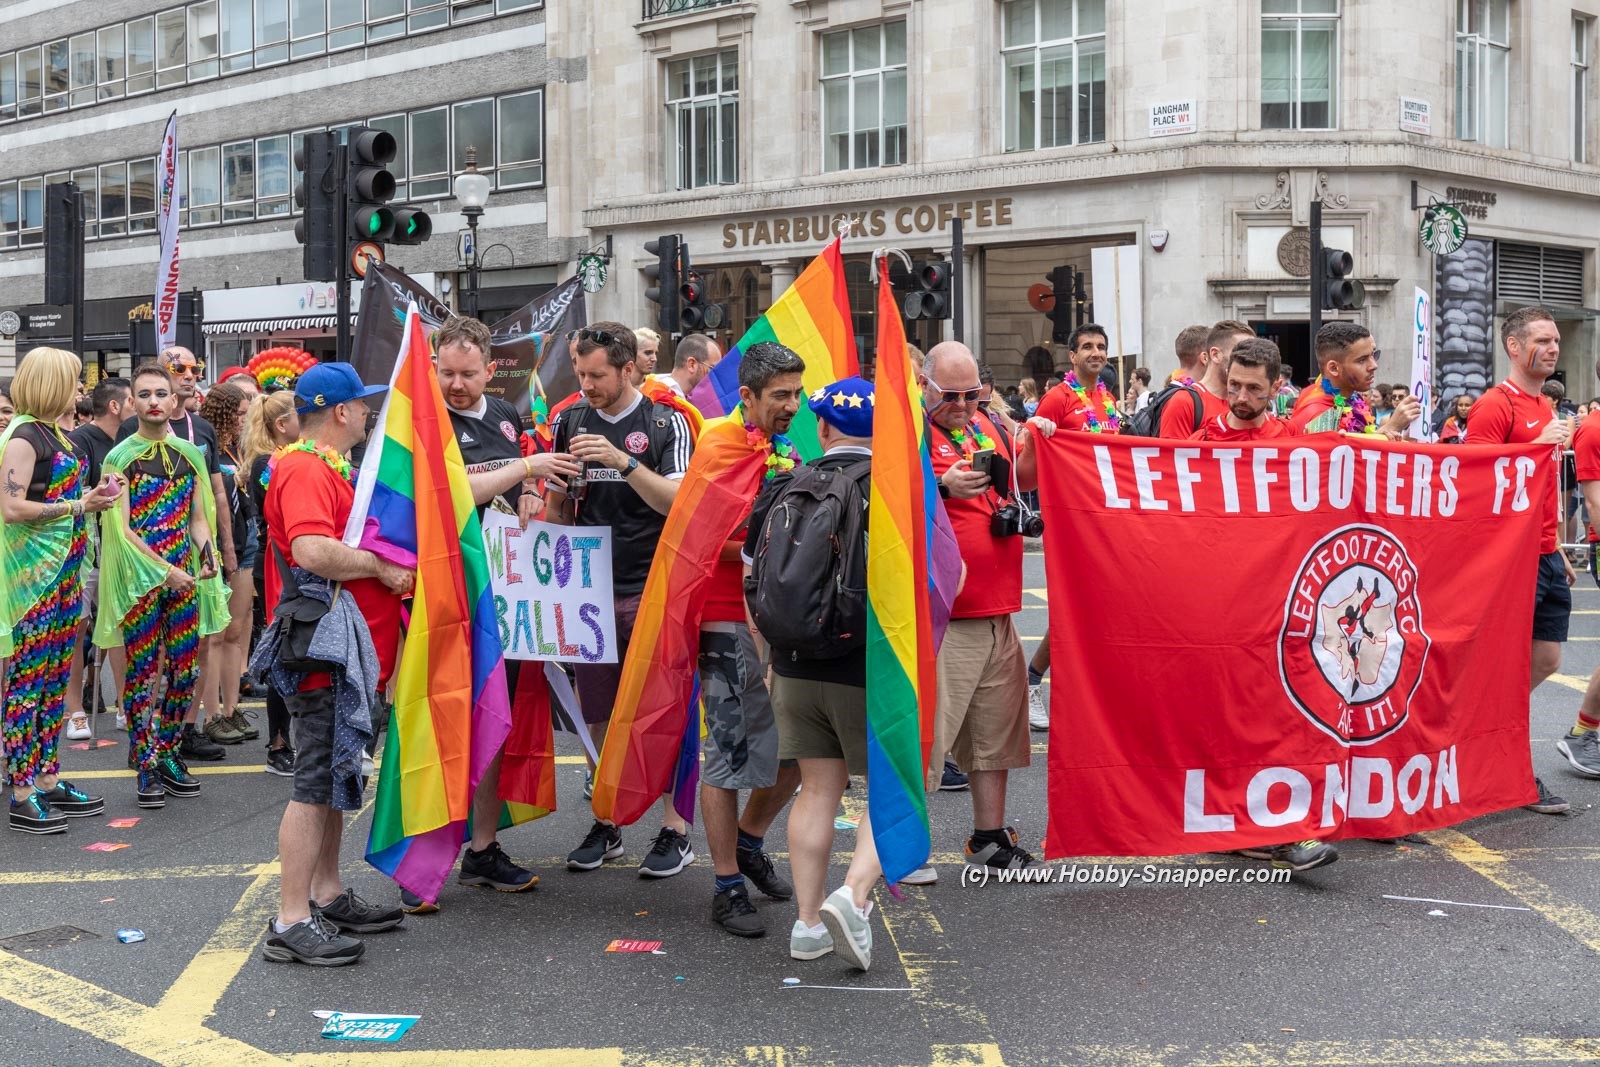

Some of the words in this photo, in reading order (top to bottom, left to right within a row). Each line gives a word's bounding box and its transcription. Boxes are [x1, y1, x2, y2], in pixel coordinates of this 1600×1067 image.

[1153, 103, 1190, 116] LANGHAM
[1153, 115, 1176, 126] PLACE
[1178, 113, 1190, 123] W1
[1404, 100, 1428, 113] MORTIMER
[1404, 111, 1421, 122] STREET
[1446, 186, 1497, 207] STARBUCKS
[1455, 203, 1488, 220] OFFEE
[722, 209, 886, 249] STARBUCKS
[895, 198, 1013, 234] COFFEE
[160, 230, 180, 336] RUNNERS
[1093, 444, 1460, 518] LEFTFOOTERS
[1492, 455, 1536, 515] FC
[484, 526, 523, 585] WE
[532, 530, 604, 589] GOT
[1287, 534, 1412, 638] LEFTFOOTERS
[1397, 596, 1417, 634] FC
[493, 594, 605, 663] BALLS
[1364, 696, 1398, 732] IT!
[1183, 745, 1461, 833] LONDON
[342, 1021, 402, 1031] WELCO
